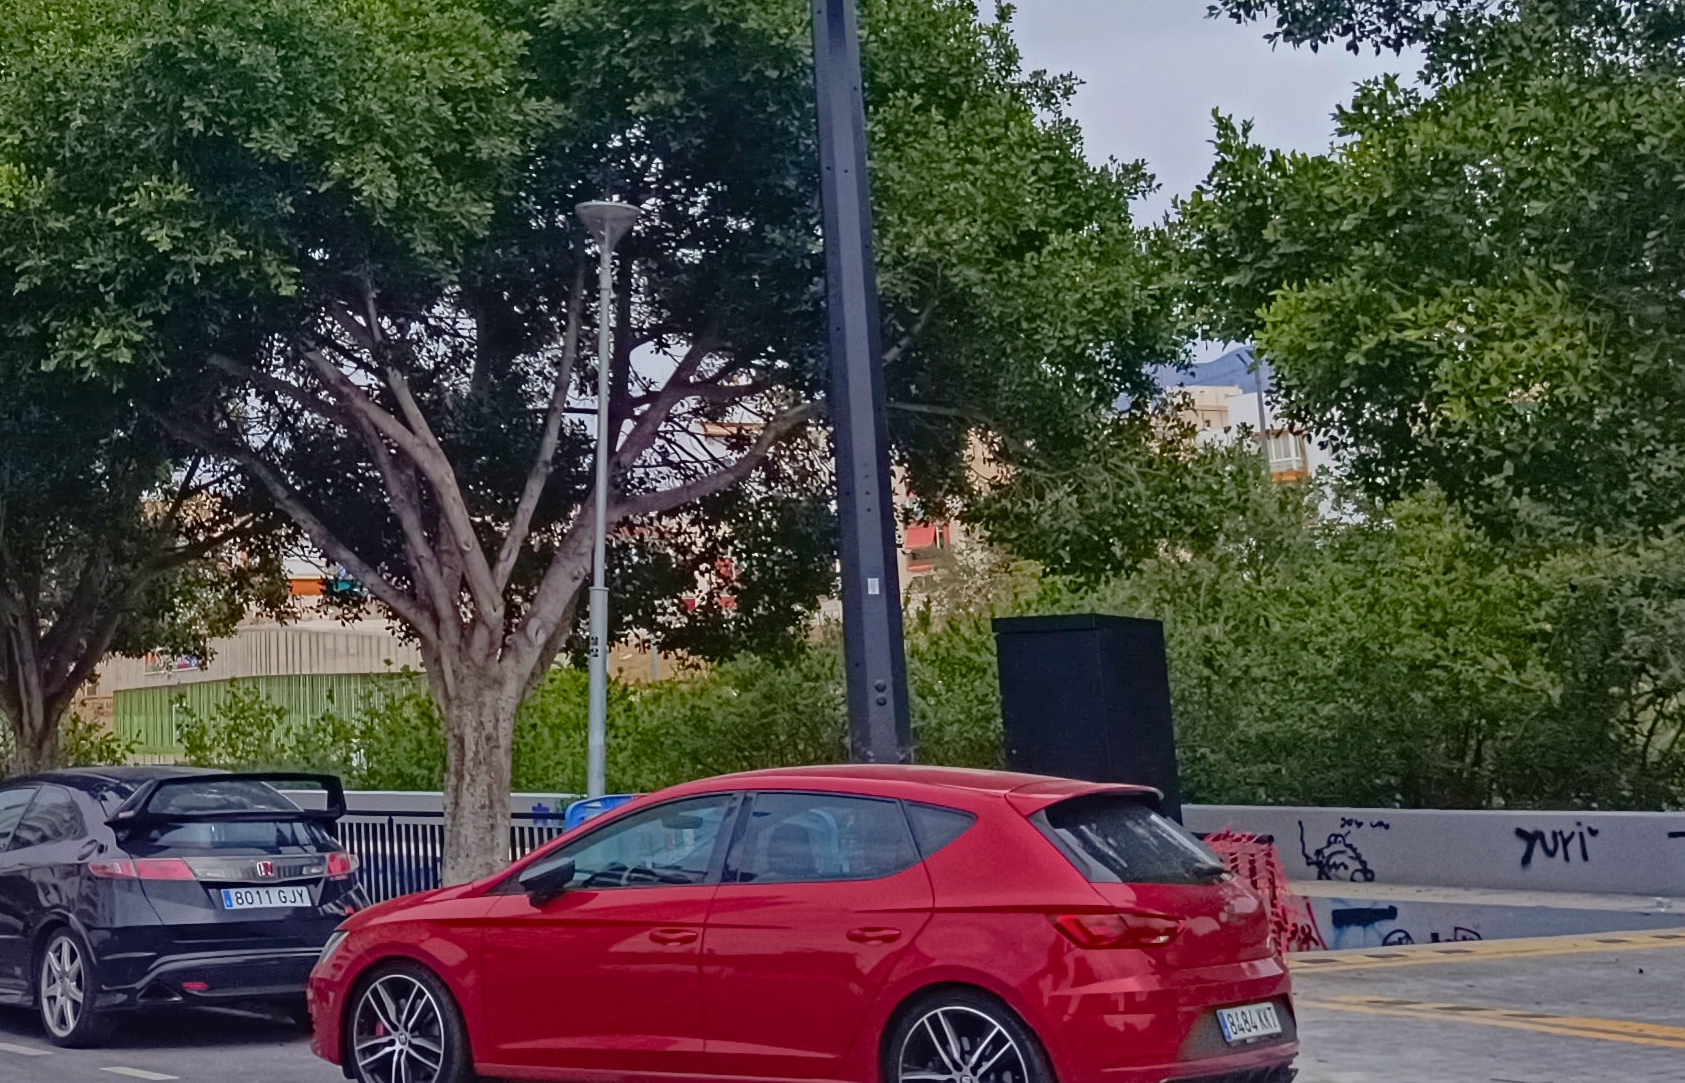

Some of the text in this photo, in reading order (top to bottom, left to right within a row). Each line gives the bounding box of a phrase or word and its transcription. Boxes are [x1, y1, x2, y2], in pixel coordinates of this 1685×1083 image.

[235, 889, 304, 906] 8011 GJY
[1226, 1010, 1258, 1035] 8484
